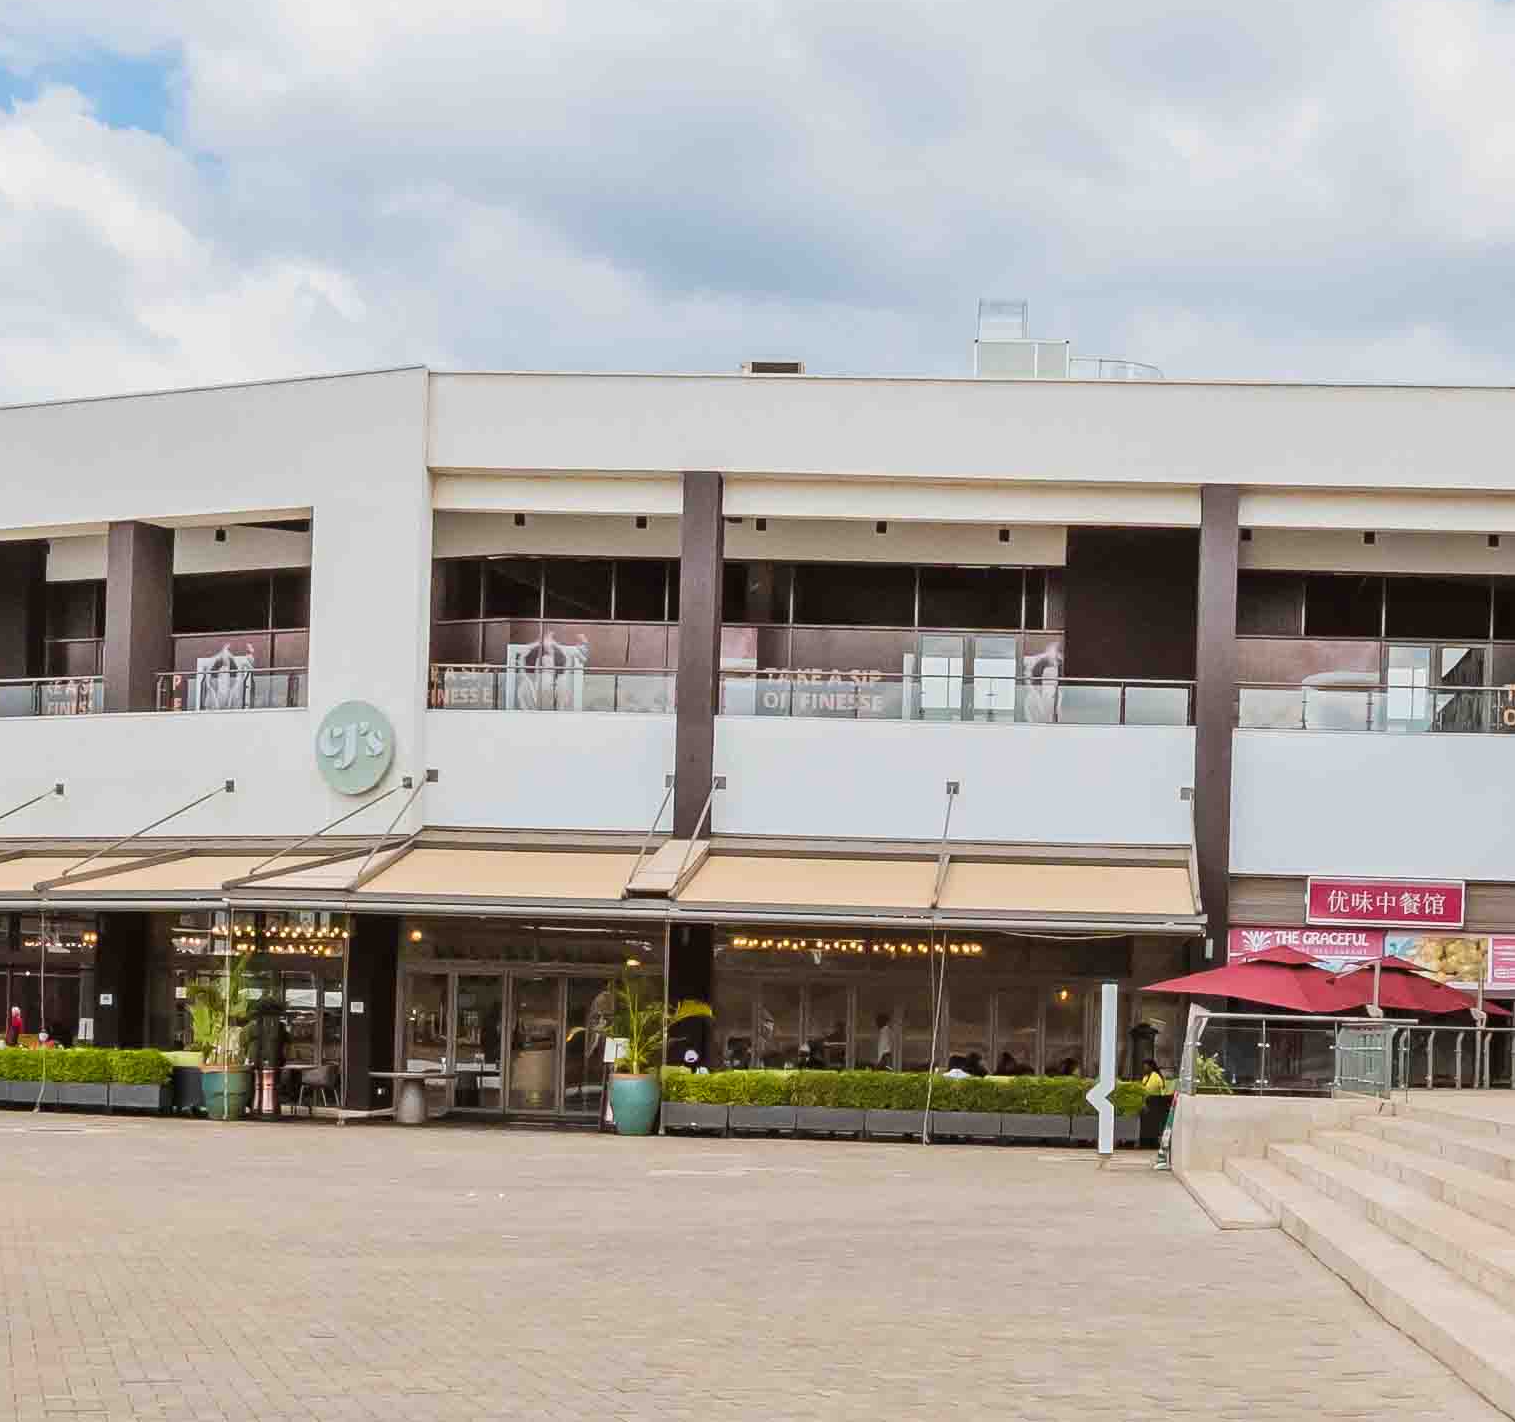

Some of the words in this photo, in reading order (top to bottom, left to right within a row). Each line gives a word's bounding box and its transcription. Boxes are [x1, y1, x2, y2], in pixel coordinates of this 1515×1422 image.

[1327, 889, 1447, 915] 优味中餐馆
[1274, 930, 1300, 947] THE
[1301, 932, 1370, 947] GRACEFUL
